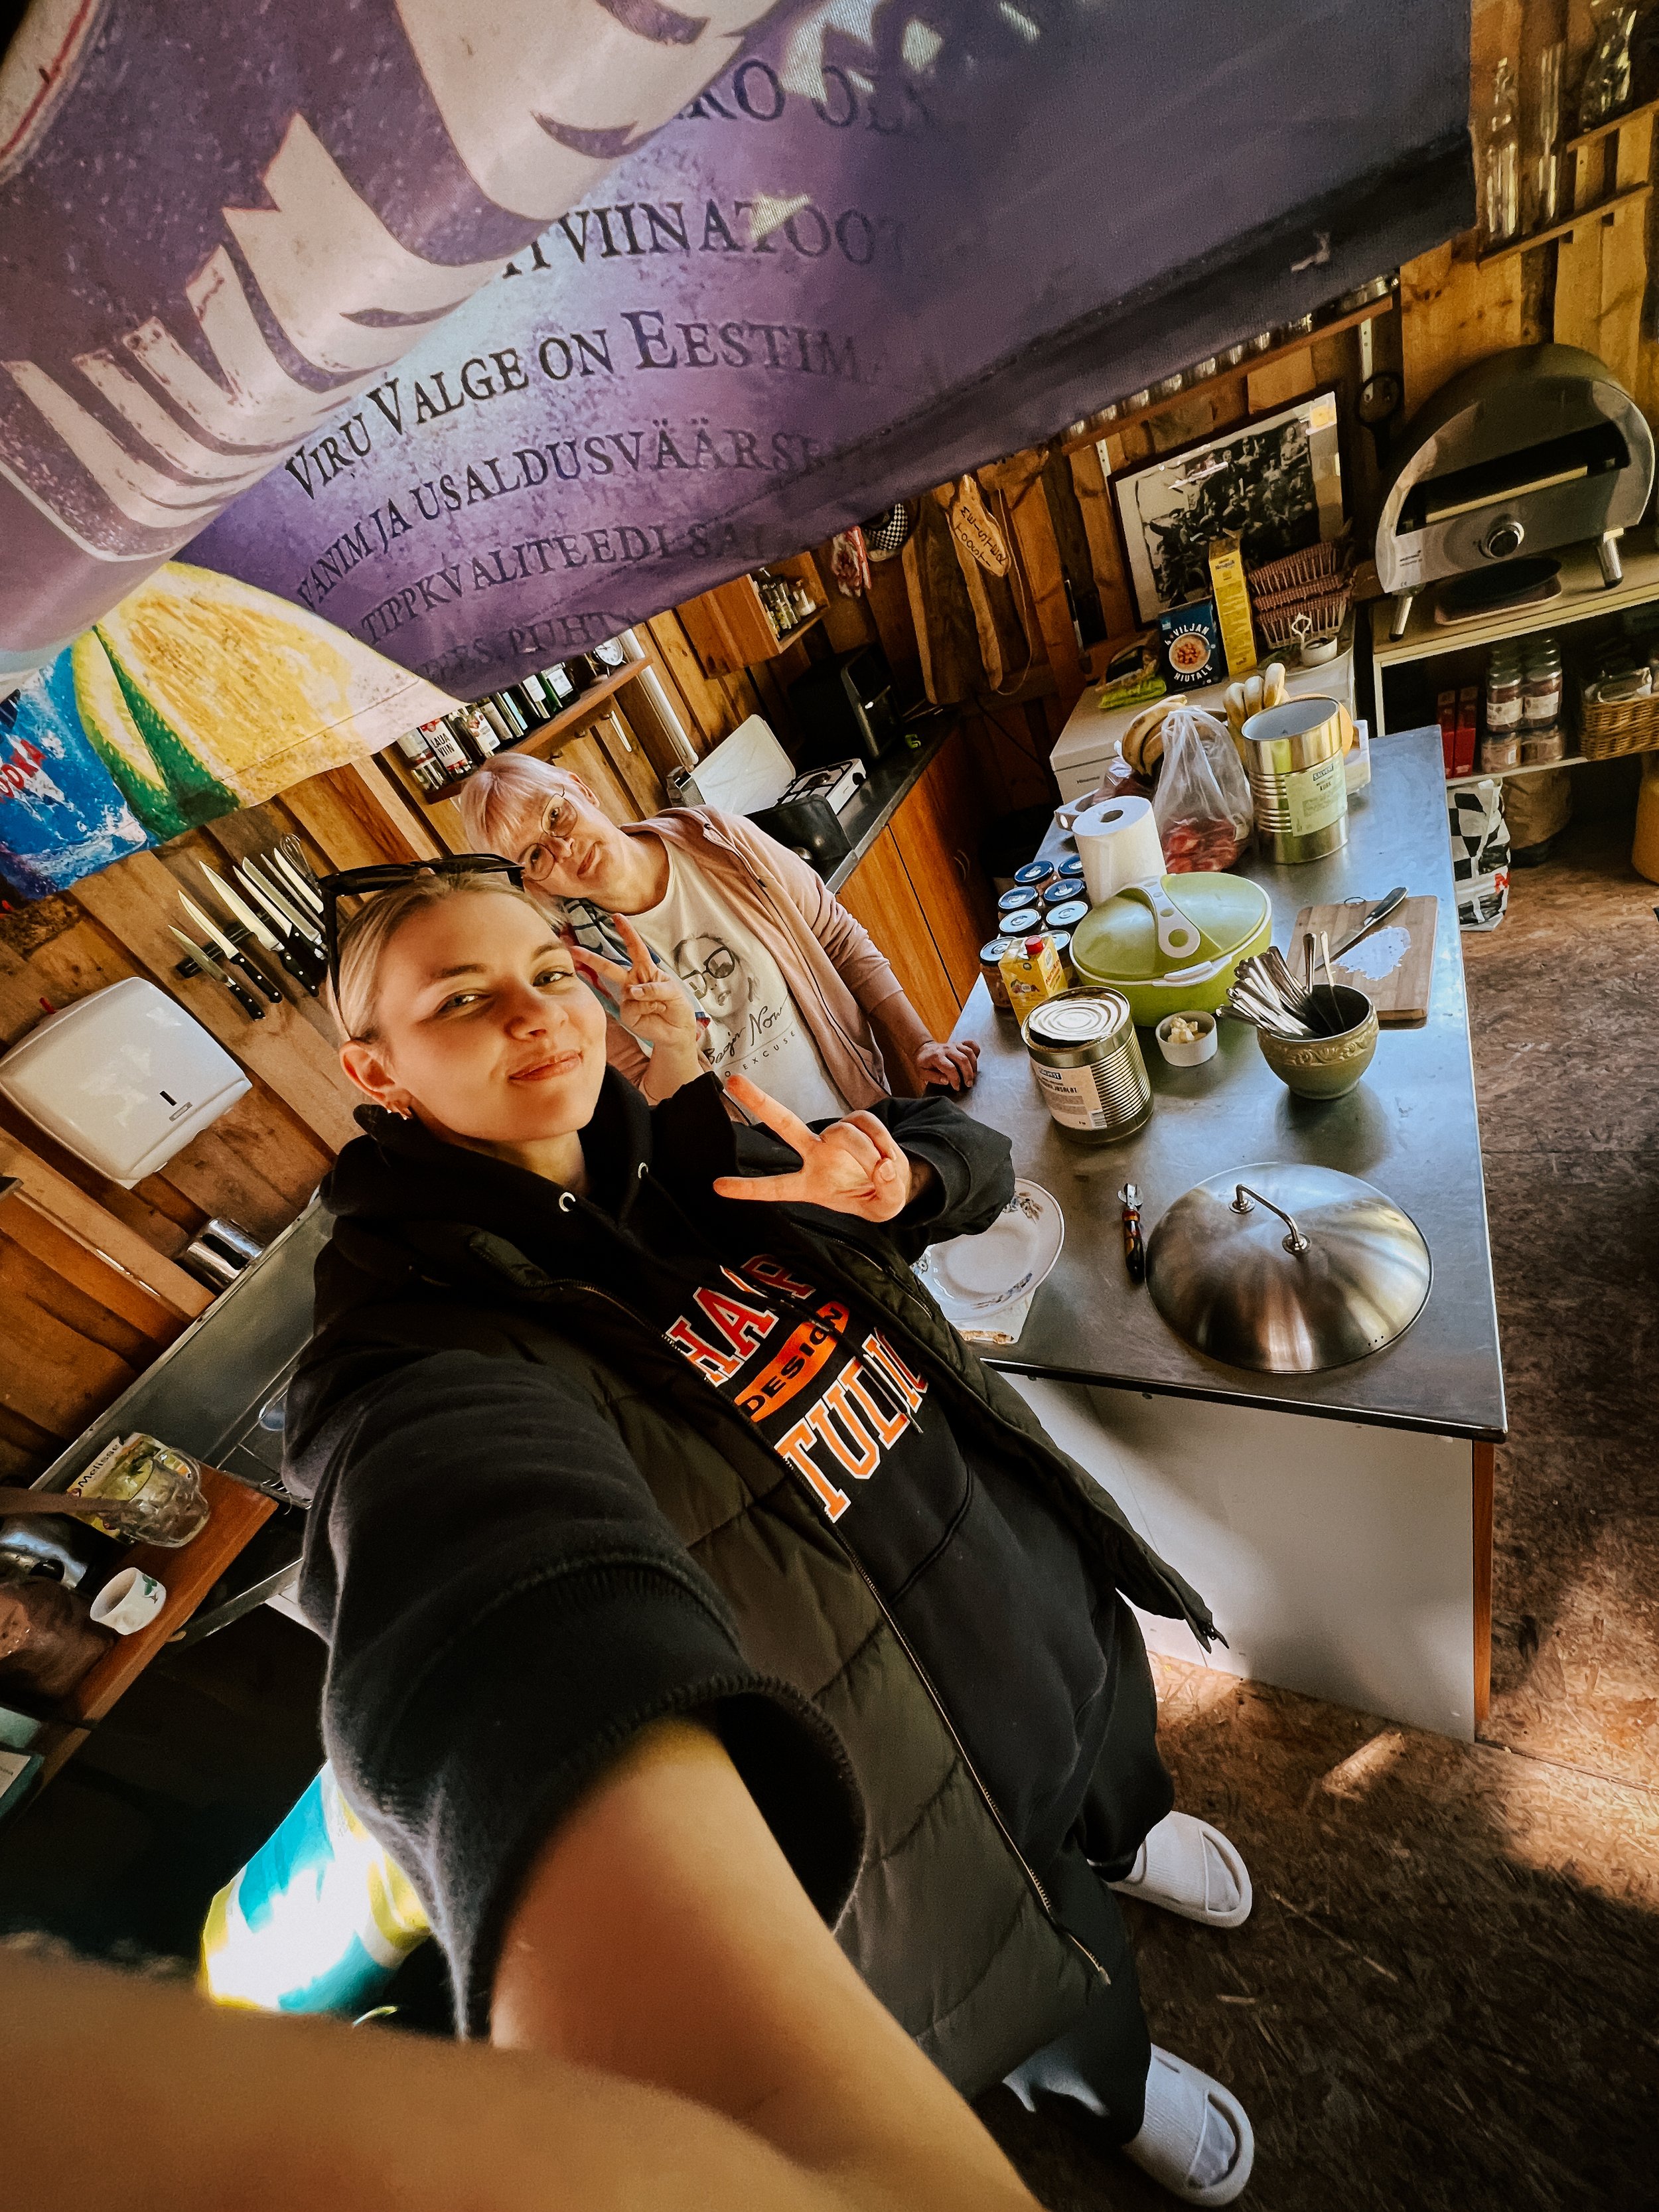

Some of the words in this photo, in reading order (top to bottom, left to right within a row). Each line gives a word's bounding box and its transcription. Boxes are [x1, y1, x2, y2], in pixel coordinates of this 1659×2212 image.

[285, 411, 371, 500] VIRU
[366, 348, 530, 435] VALGE
[538, 328, 615, 382] ON
[297, 522, 374, 611] VANIM
[369, 498, 413, 555] JA
[960, 506, 1007, 565] MEISTER
[1173, 623, 1210, 636] VILJAN
[0, 737, 47, 804] ODKA
[430, 733, 451, 749] LAUA
[437, 743, 455, 757] VIIN
[703, 1026, 747, 1065] Begin
[749, 1005, 784, 1047] Now
[742, 1031, 796, 1070] EXCUSE
